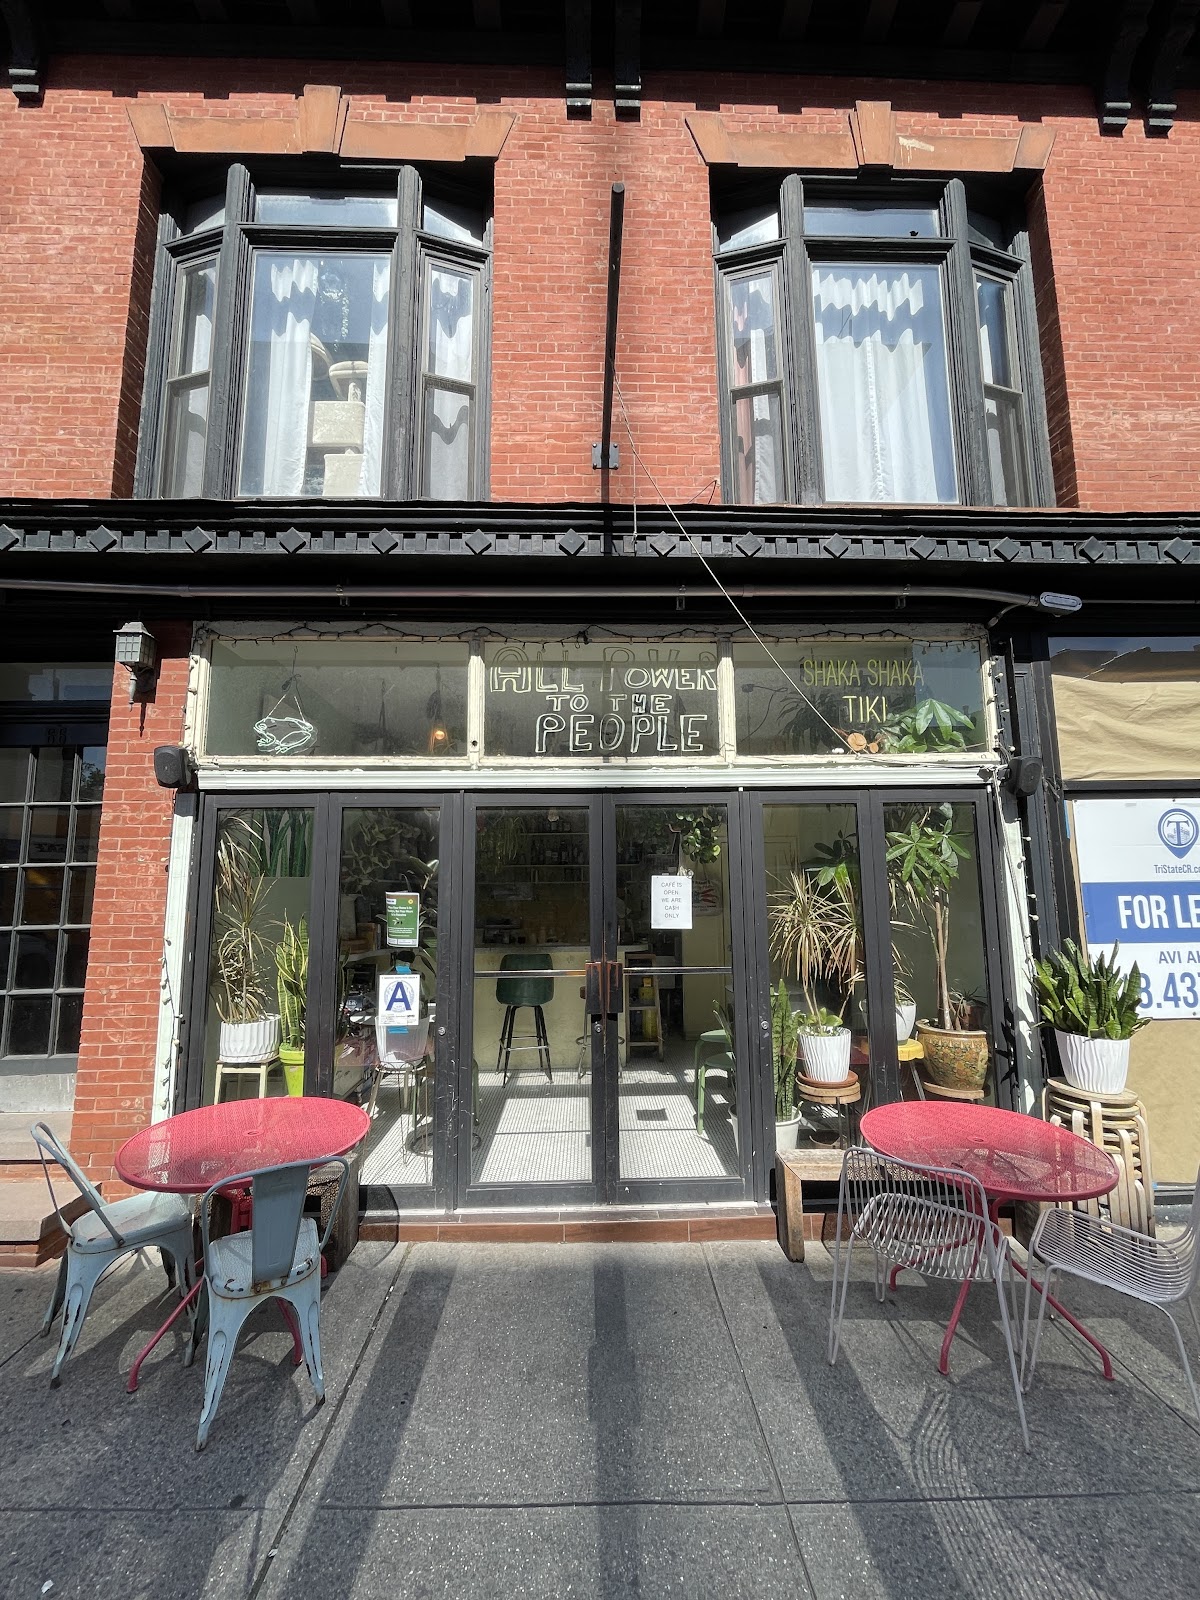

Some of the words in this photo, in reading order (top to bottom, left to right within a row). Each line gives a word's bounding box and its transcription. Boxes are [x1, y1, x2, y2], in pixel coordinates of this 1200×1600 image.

[490, 646, 584, 693] ALL
[600, 647, 717, 692] POWER
[803, 660, 861, 686] SHAKA
[867, 660, 925, 686] SHAKA
[546, 694, 589, 713] TO
[608, 693, 673, 714] THE
[842, 695, 887, 724] TIKI
[535, 713, 708, 753] PEOPLE
[1117, 895, 1170, 929] FOR
[1159, 950, 1182, 965] AVI
[386, 981, 412, 1011] A
